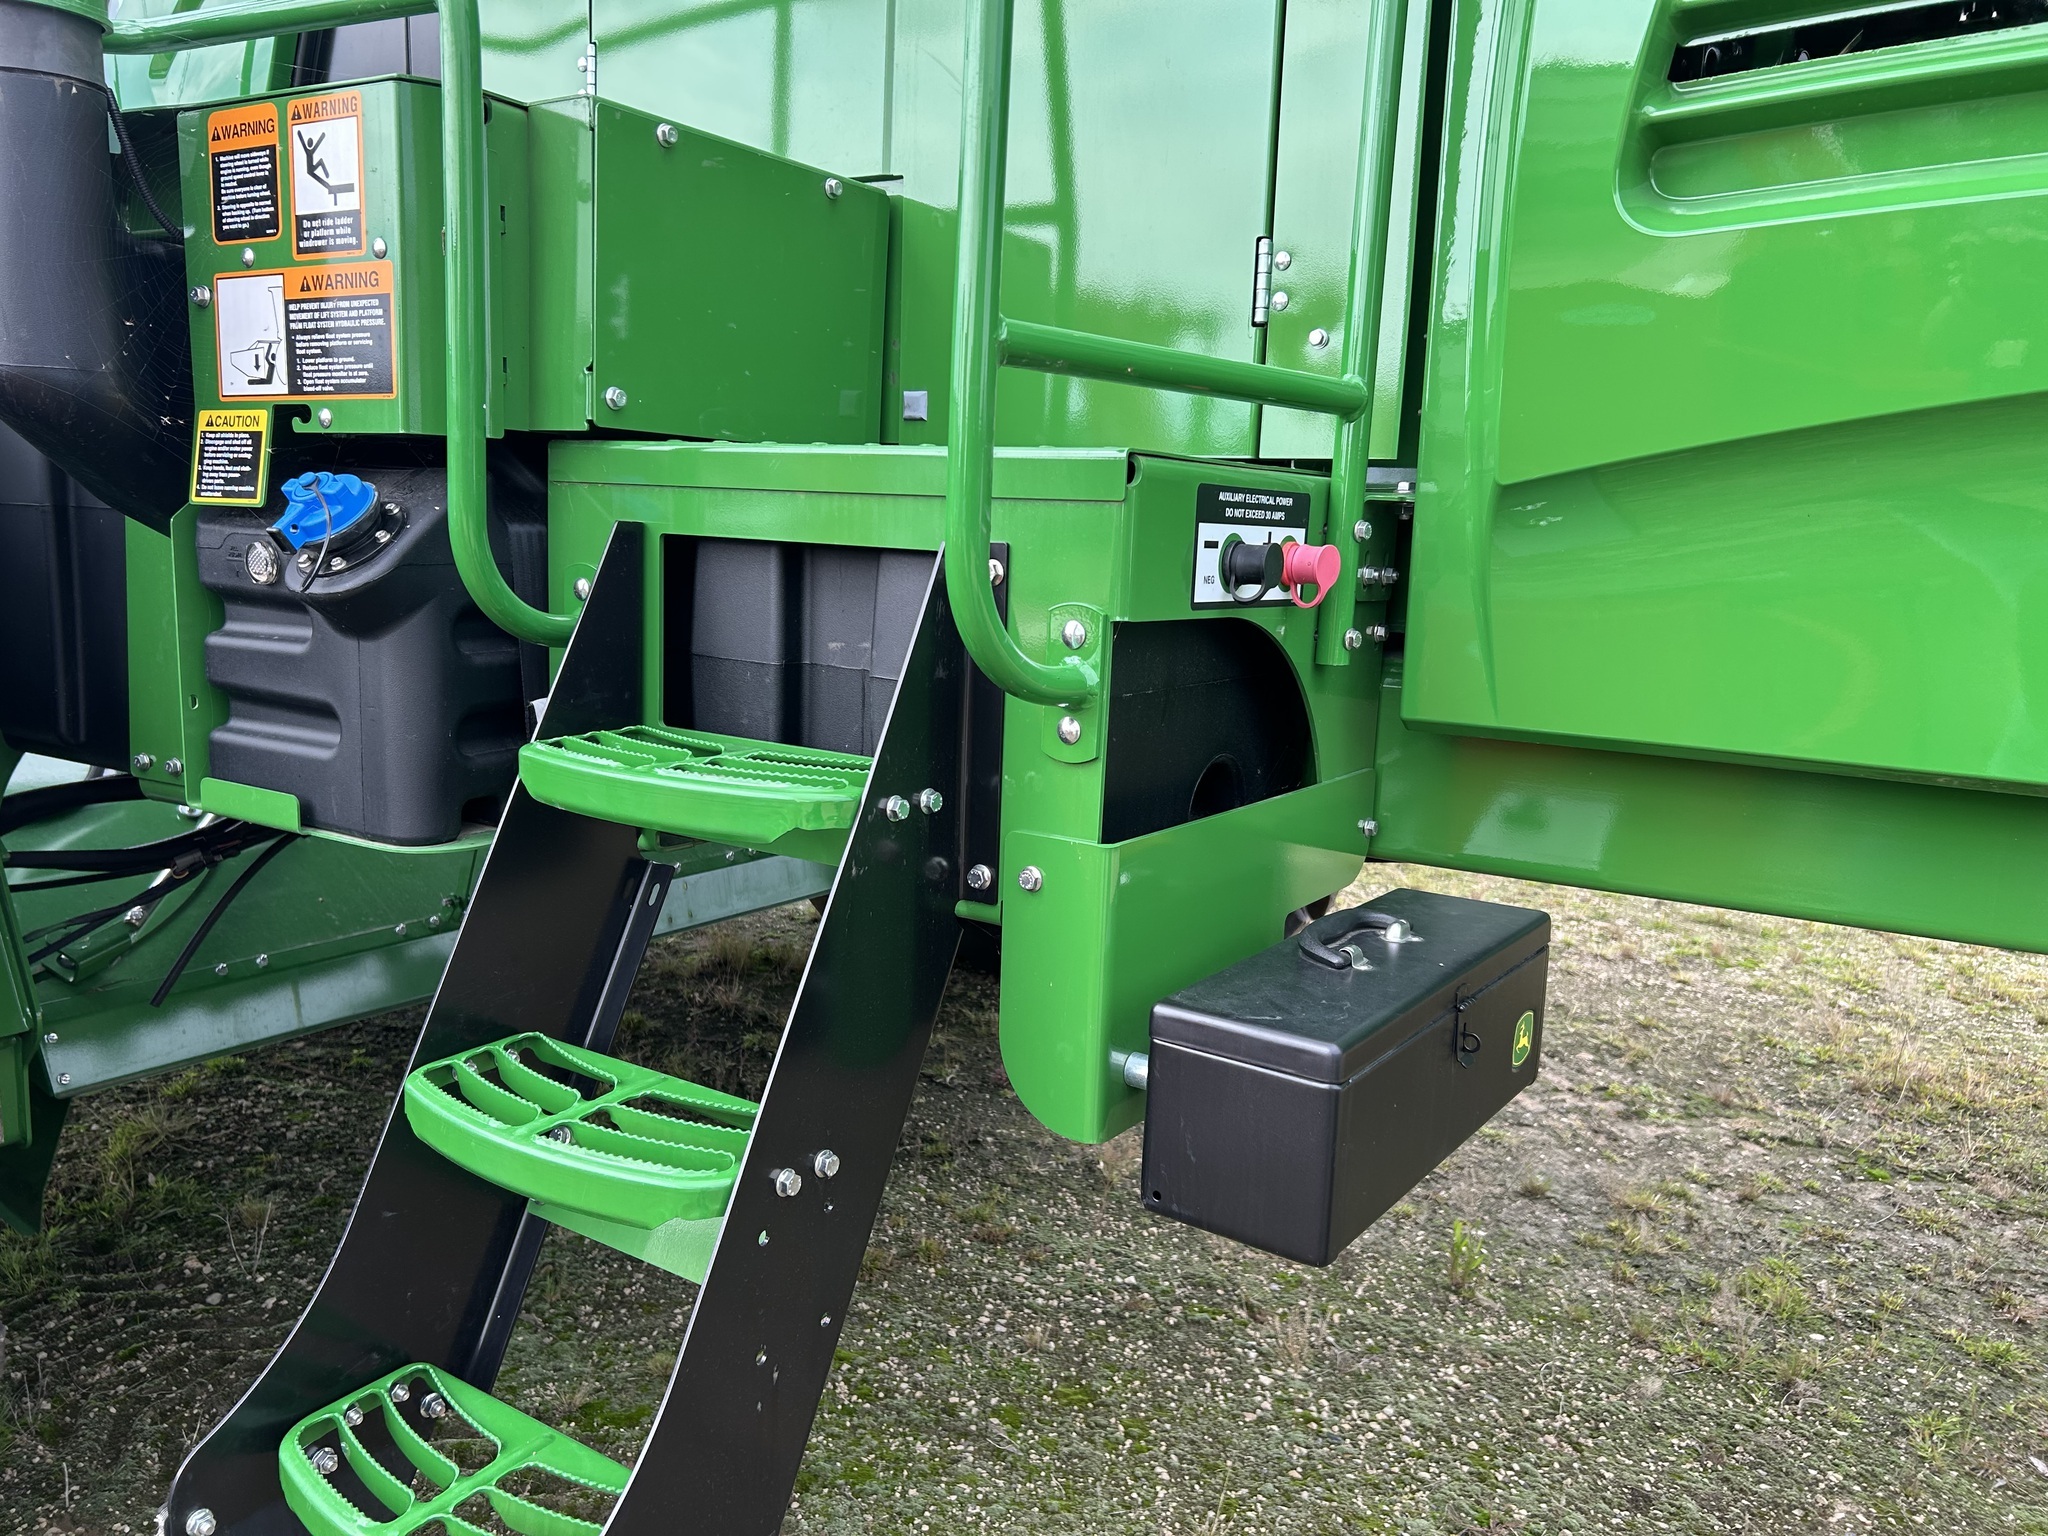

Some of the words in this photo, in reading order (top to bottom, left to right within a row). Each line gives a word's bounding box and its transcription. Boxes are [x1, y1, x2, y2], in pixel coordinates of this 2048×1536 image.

[302, 96, 357, 119] WARNING
[221, 118, 274, 140] WARNING
[335, 216, 353, 225] ladder
[311, 229, 334, 238] platform
[299, 239, 328, 247] windrower
[336, 236, 358, 245] moving.
[312, 271, 379, 290] WARNING
[215, 416, 259, 427] CAUTION
[1219, 492, 1245, 501] AUXILIARY
[1246, 494, 1275, 504] ELECTRICAL
[1276, 497, 1293, 506] POWER
[1226, 508, 1234, 516] DO
[1234, 508, 1245, 518] NOT
[1246, 509, 1265, 519] EXCEED
[1266, 511, 1271, 519] 30
[1272, 511, 1285, 520] AMPS
[1204, 576, 1214, 584] NEG
